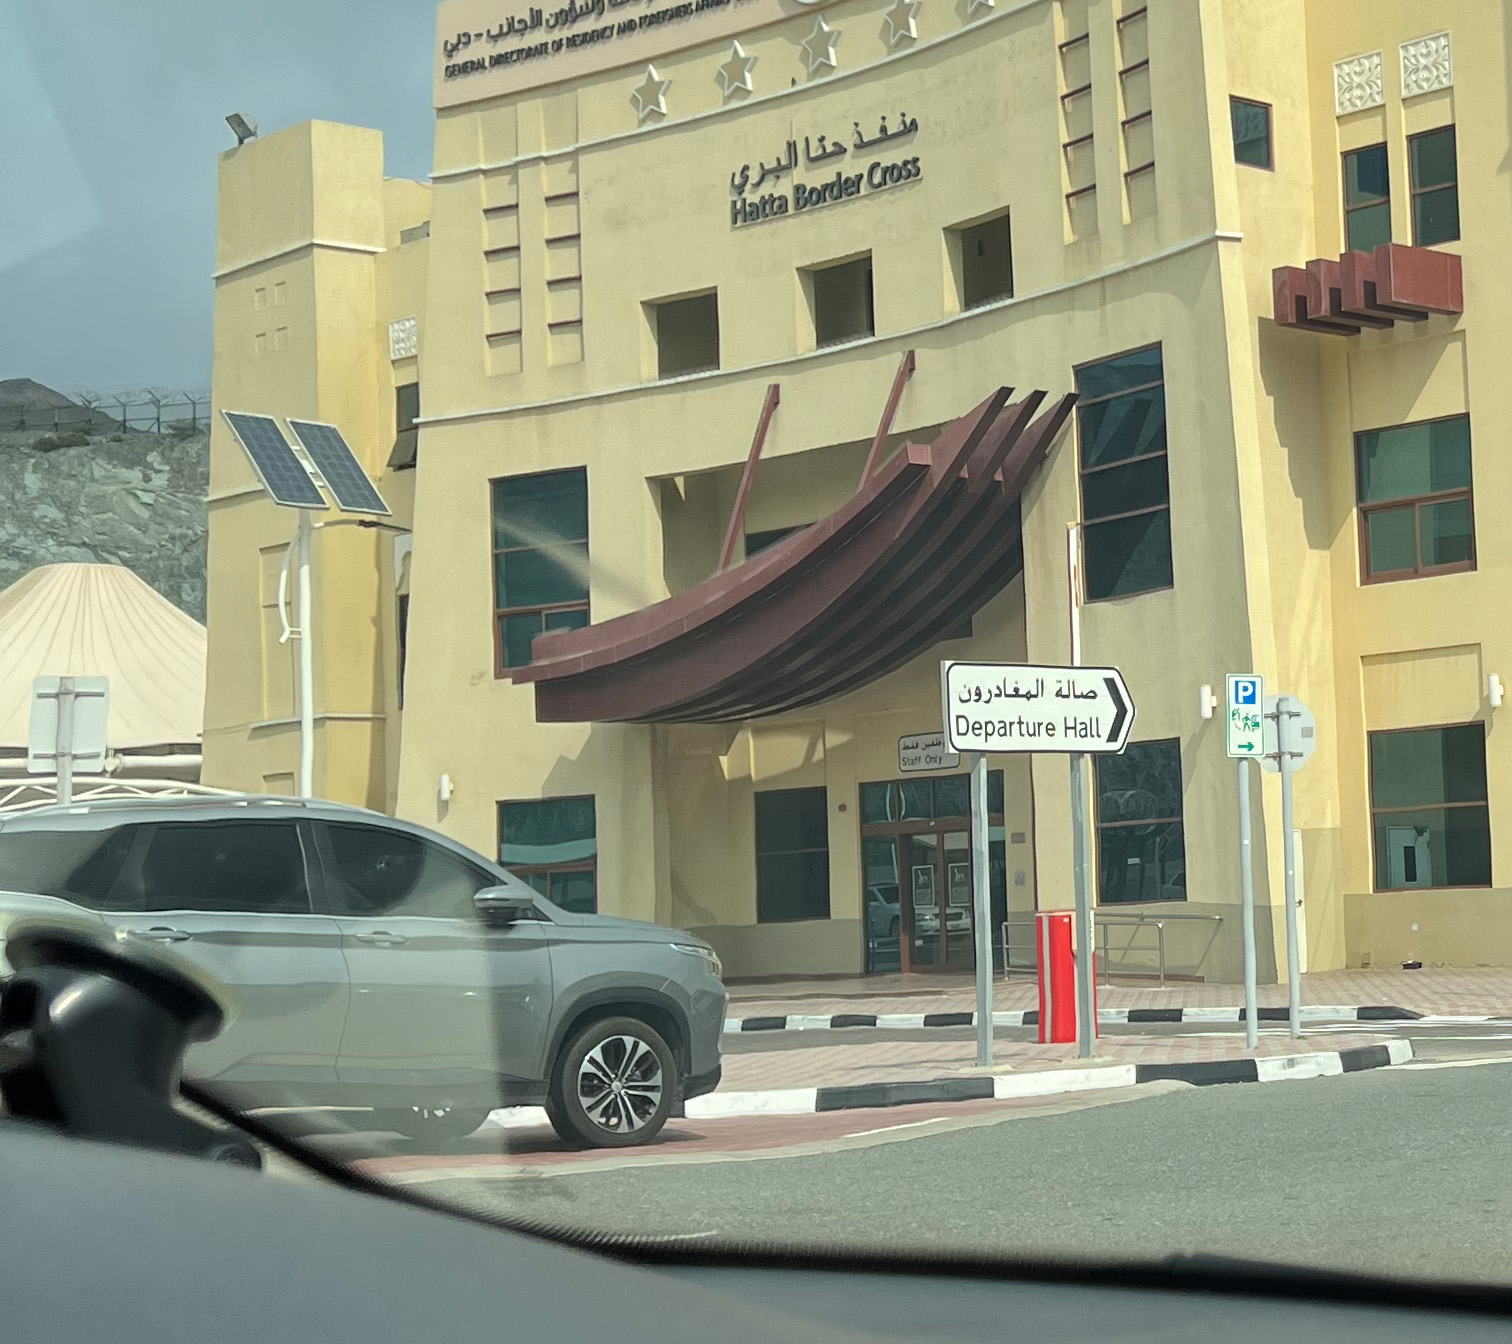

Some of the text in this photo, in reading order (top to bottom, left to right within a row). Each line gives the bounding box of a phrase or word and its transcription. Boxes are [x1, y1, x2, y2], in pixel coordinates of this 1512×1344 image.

[486, 7, 543, 43] الأجانب
[443, 32, 472, 58] دبي
[445, 57, 488, 78] GENERAL
[489, 41, 549, 68] DIRECTORATE
[552, 37, 564, 52] OF
[616, 19, 637, 35] AND
[731, 112, 919, 196] منفذ حتا البري
[731, 156, 921, 225] Hatta Border Cross
[958, 677, 1098, 704] صالة المغادرون
[1238, 682, 1254, 704] P
[955, 714, 1102, 743] Departure Hall
[902, 755, 942, 766] Staff Only
